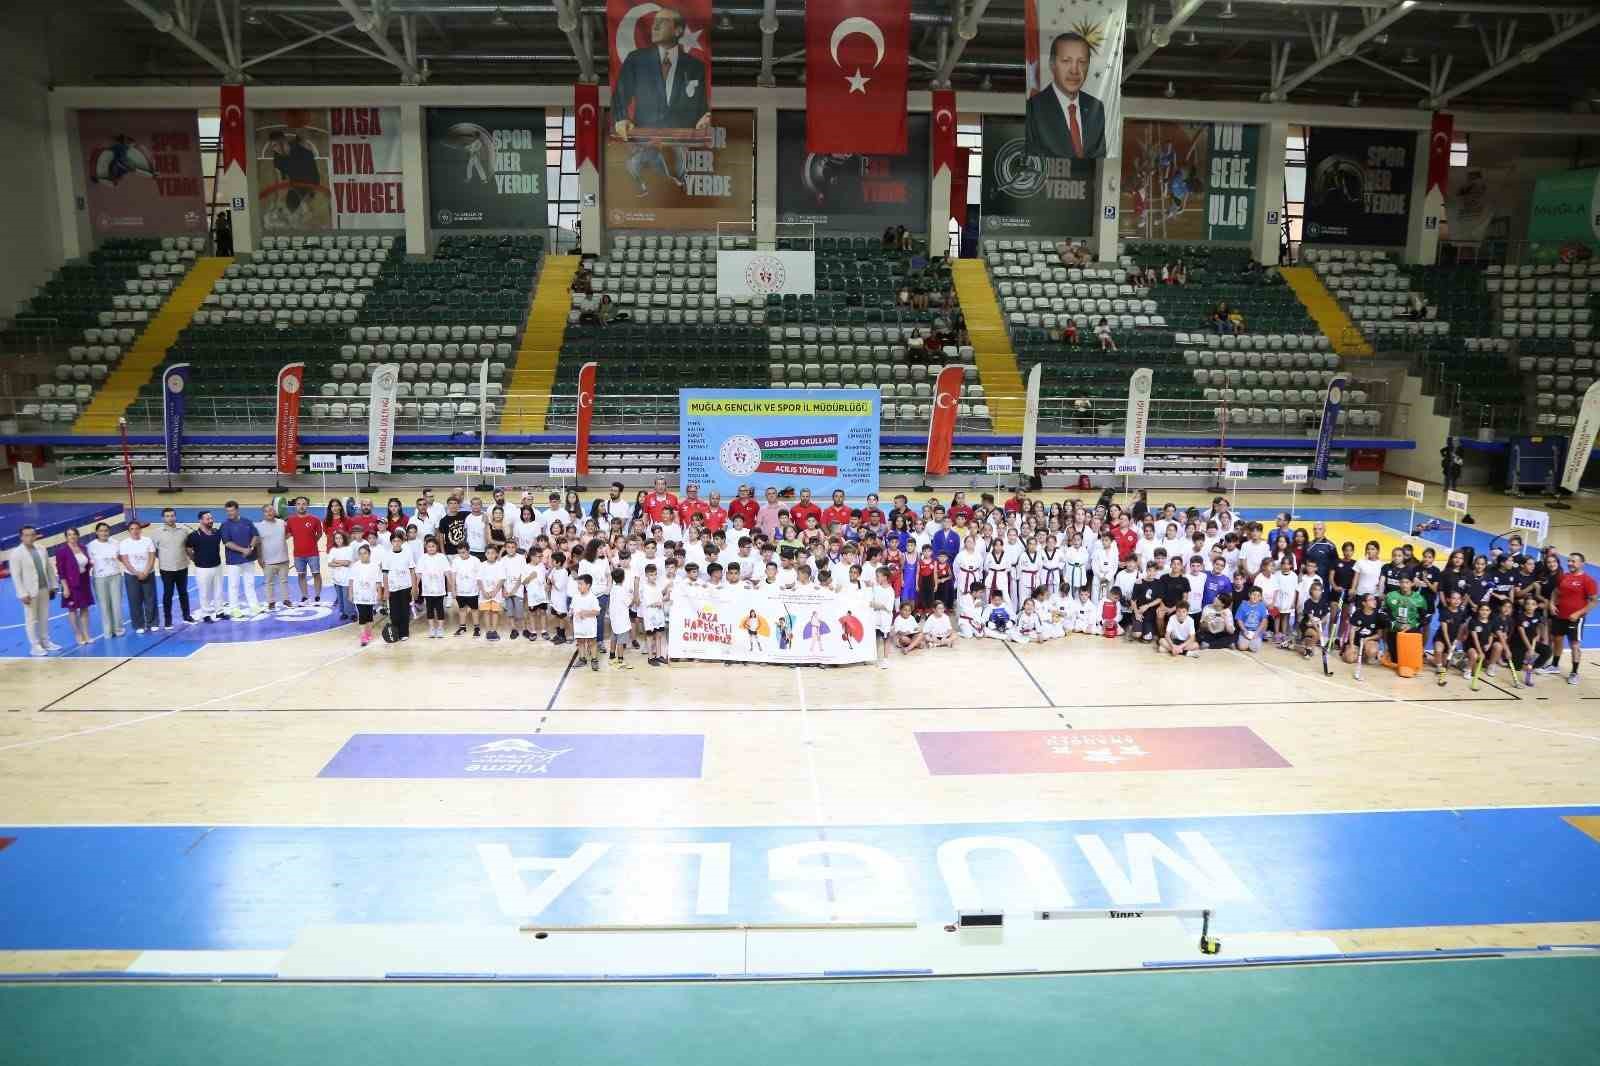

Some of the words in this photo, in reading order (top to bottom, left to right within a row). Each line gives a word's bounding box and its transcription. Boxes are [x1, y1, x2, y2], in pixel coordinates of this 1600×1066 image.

[493, 129, 533, 150] SPOR
[494, 152, 521, 172] HER
[495, 173, 540, 195] YERDE
[686, 175, 732, 196] YERDE
[1045, 179, 1087, 200] YERDE
[1363, 192, 1406, 215] YERDE
[691, 402, 723, 412] MUĞLA
[724, 402, 762, 413] GENÇLİK
[764, 403, 776, 412] VE
[778, 402, 801, 412] SPOR
[779, 439, 799, 447] SPOR
[800, 437, 835, 446] OKULLARI
[775, 465, 798, 474] AÇILIŞ
[799, 465, 825, 475] TÖRENİ
[696, 610, 718, 622] YAZA
